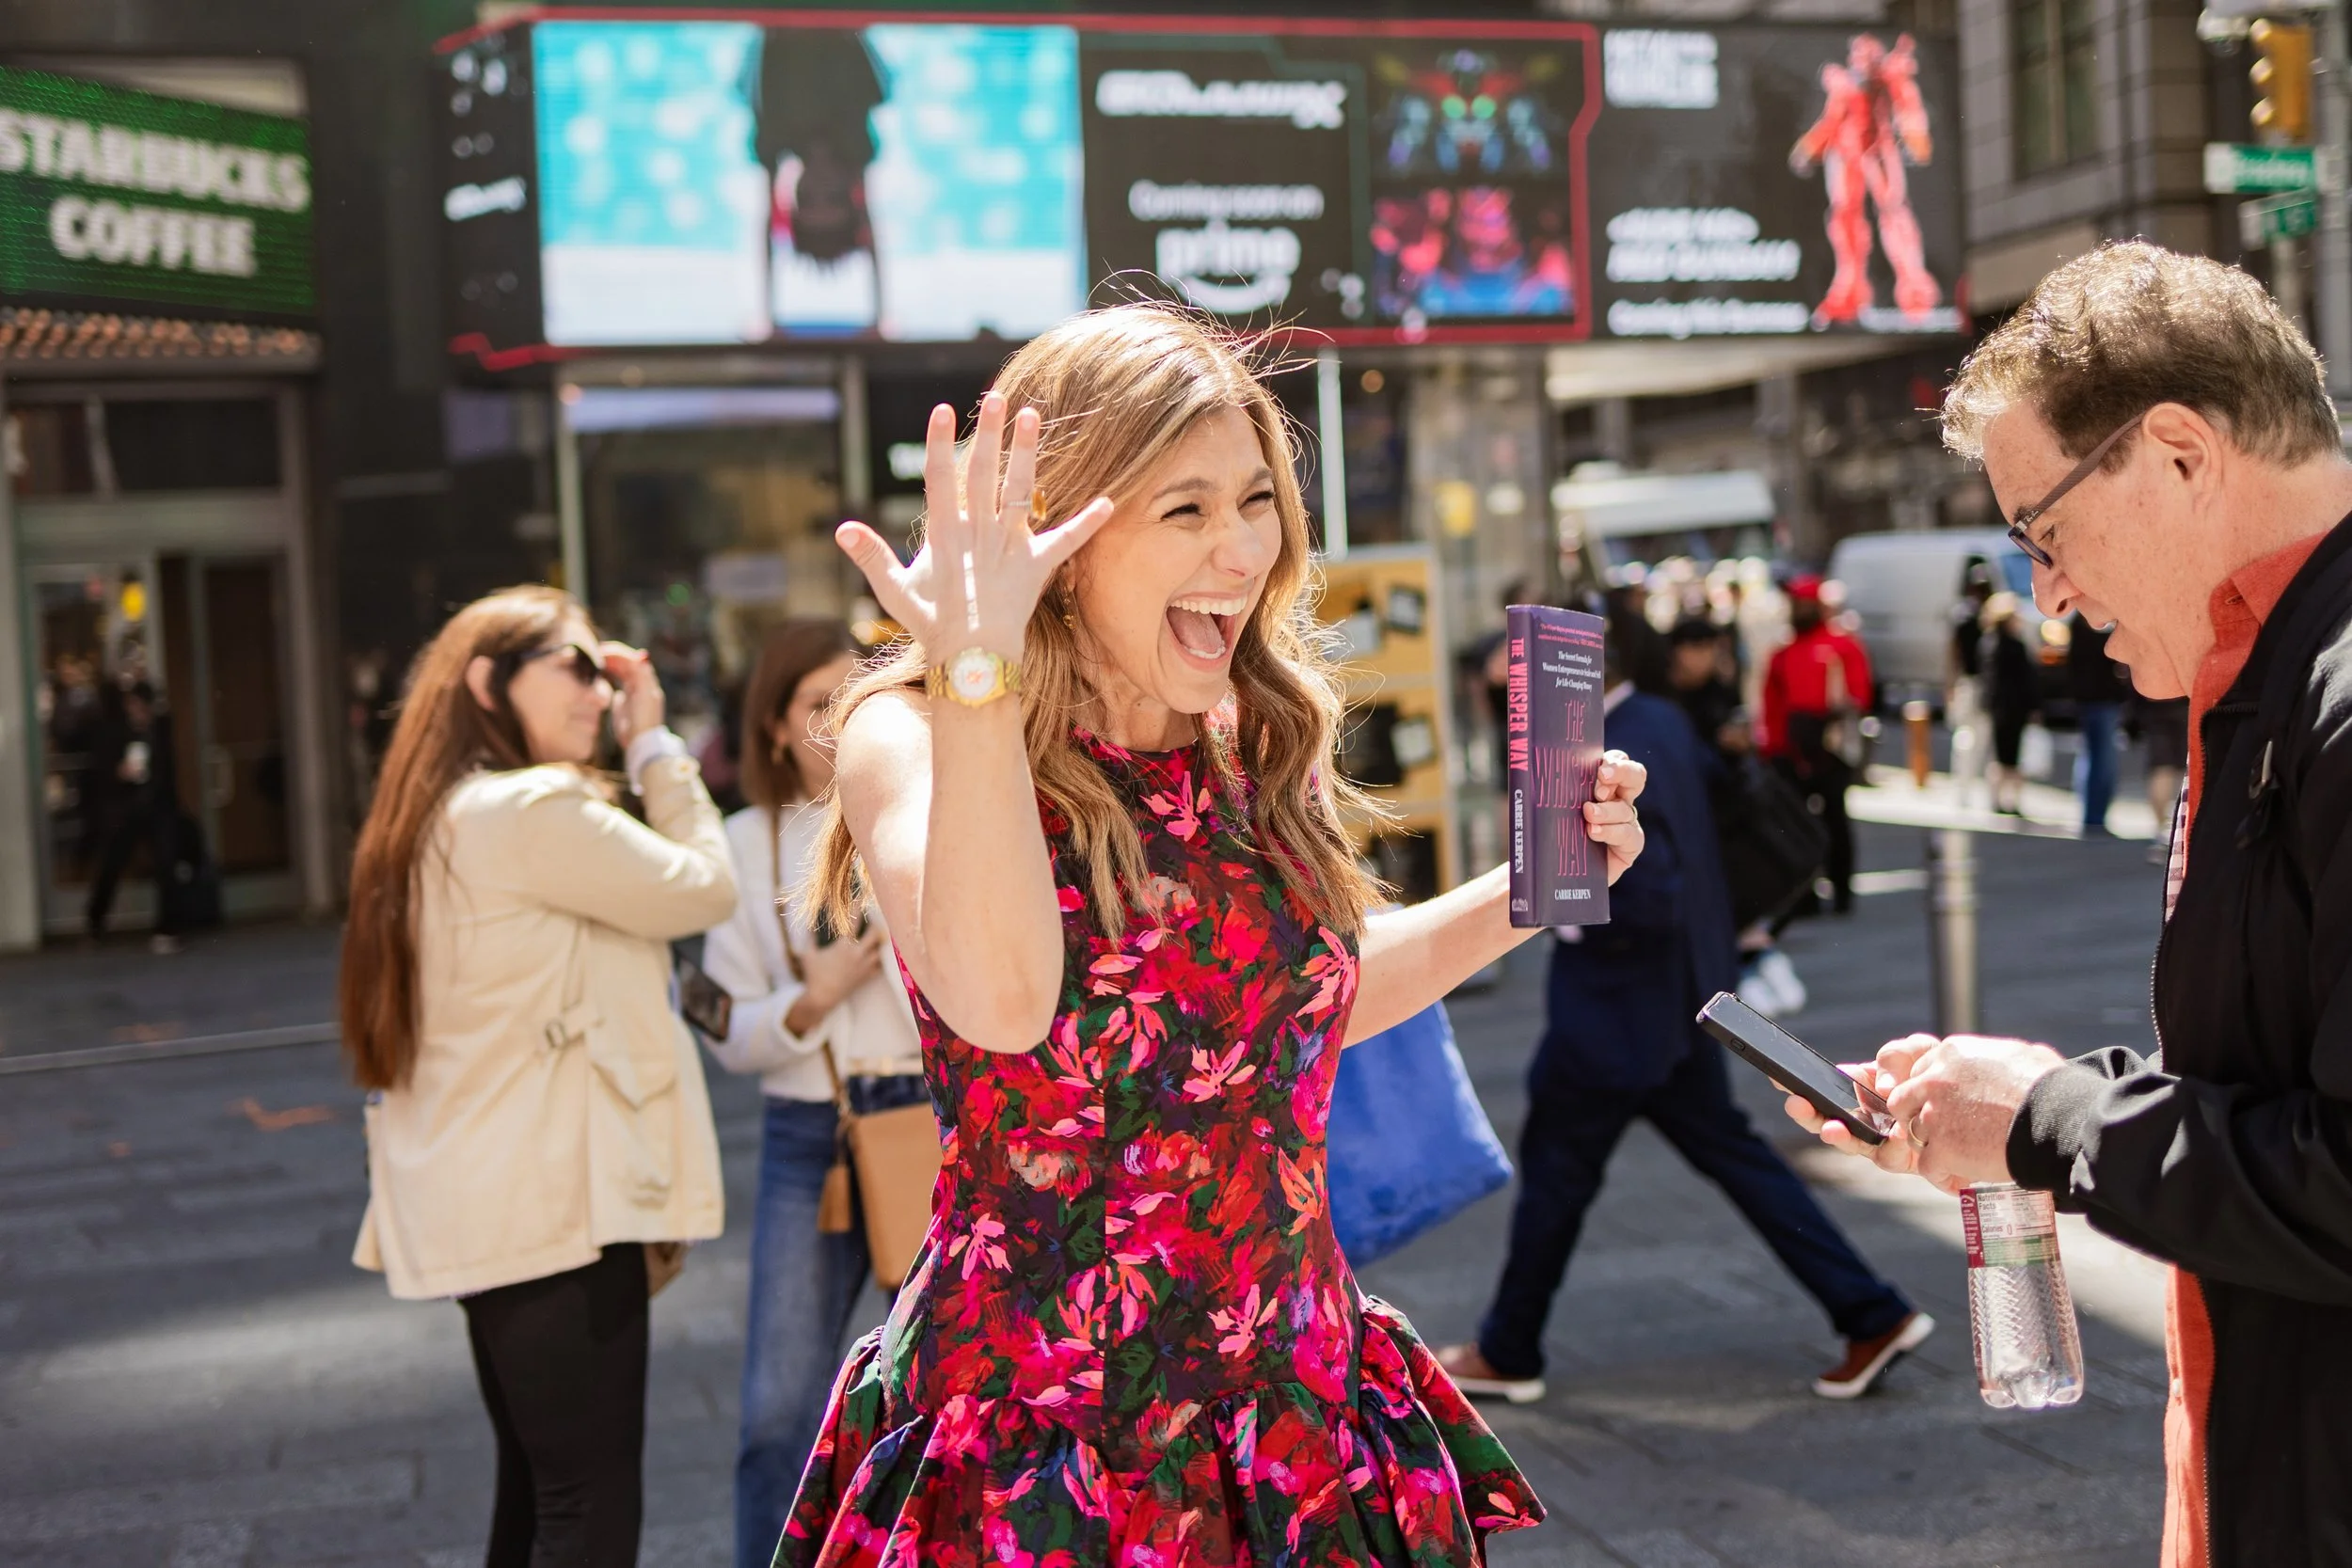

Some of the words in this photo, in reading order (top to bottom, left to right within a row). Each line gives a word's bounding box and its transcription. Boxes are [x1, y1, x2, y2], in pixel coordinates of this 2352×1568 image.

[0, 106, 311, 214] STARBUCKS
[51, 195, 258, 278] COFFEE
[1155, 222, 1301, 286] prime
[1511, 638, 1524, 658] THE
[1509, 661, 1528, 733] WHISPER
[1565, 700, 1585, 742] THE
[1510, 737, 1529, 771] WAY
[1535, 745, 1603, 810] WHISPE
[1515, 788, 1523, 831] CARRIE
[1556, 816, 1588, 877] WAY
[1554, 888, 1572, 900] CARRIE
[1572, 888, 1592, 900] KERPEN
[1978, 1193, 2006, 1202] Nutrition
[1979, 1202, 1996, 1211] Facts
[1982, 1224, 2003, 1234] Calories
